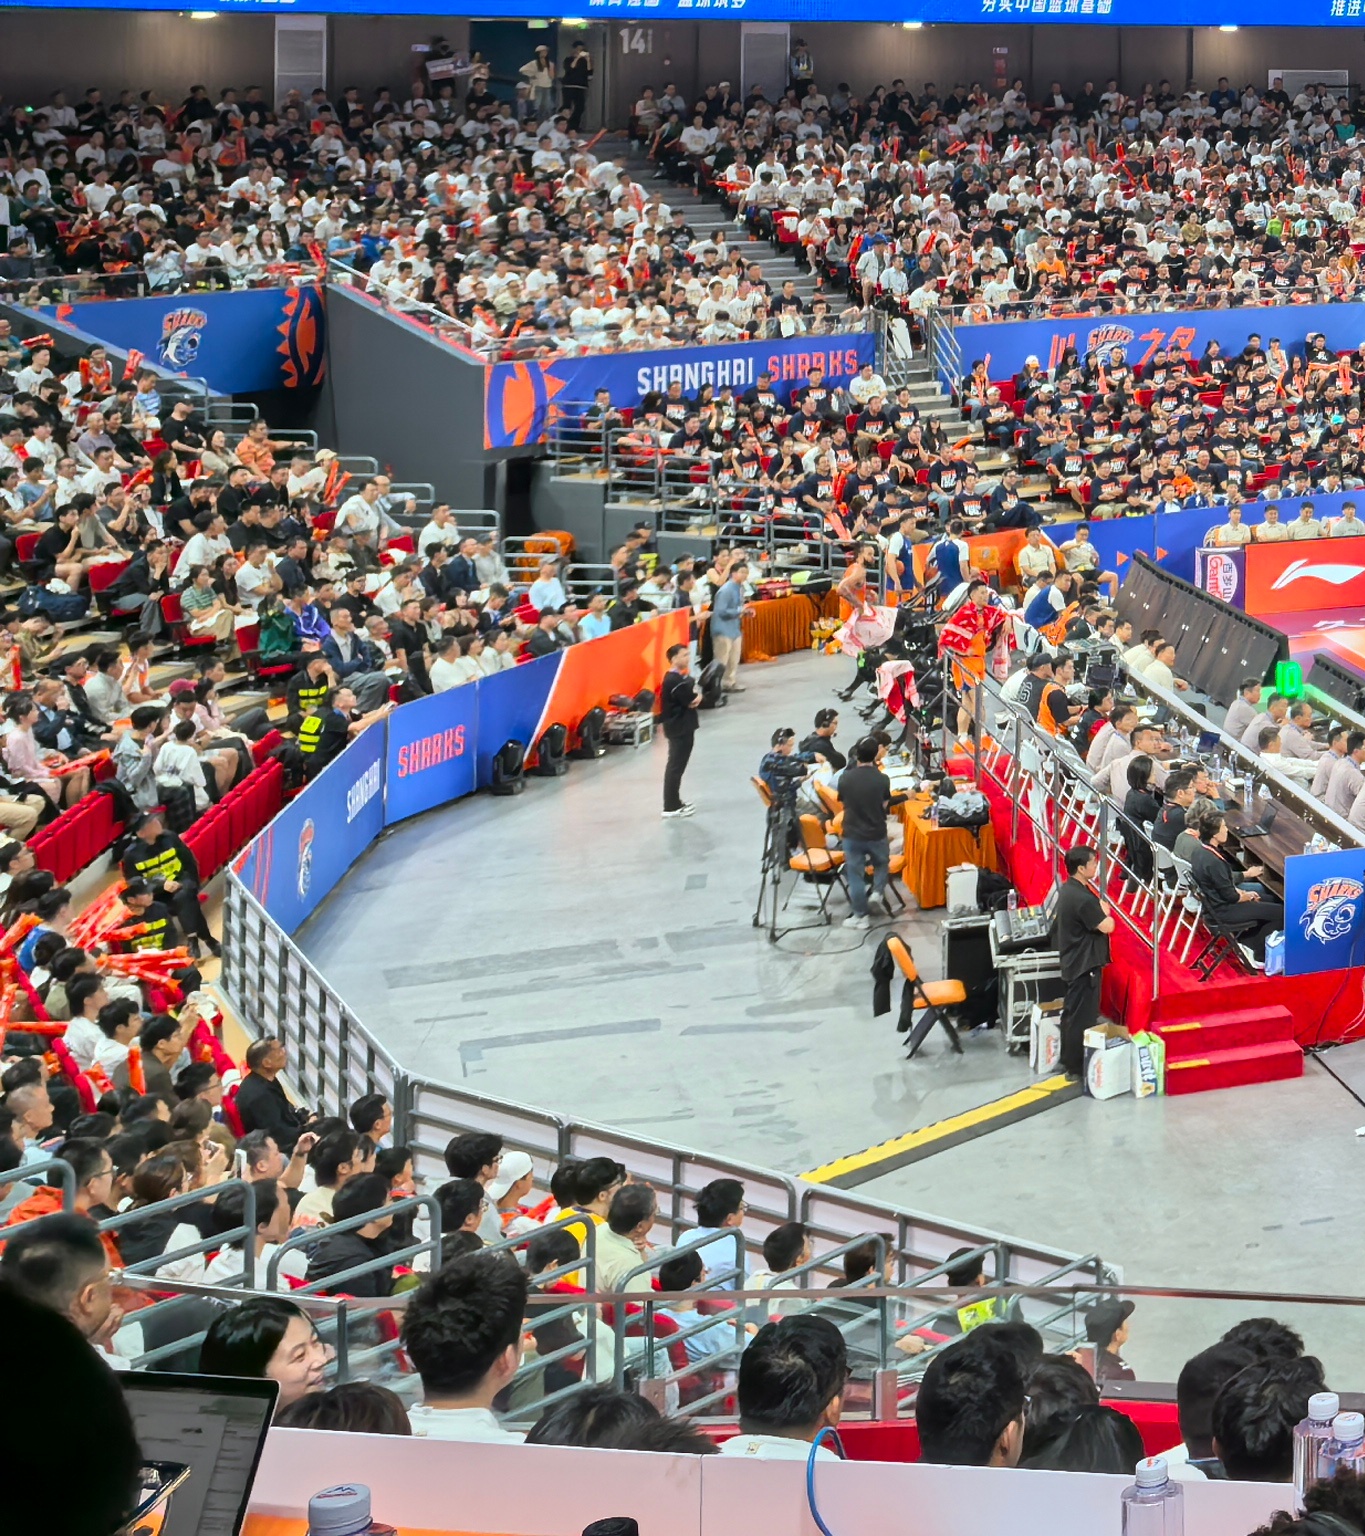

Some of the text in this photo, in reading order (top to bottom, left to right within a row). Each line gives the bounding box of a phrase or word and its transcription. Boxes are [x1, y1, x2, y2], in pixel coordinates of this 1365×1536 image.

[619, 28, 646, 54] 14
[638, 349, 860, 395] SHANGHAI SHARKS
[346, 724, 466, 824] SHANGHAI SHARKS
